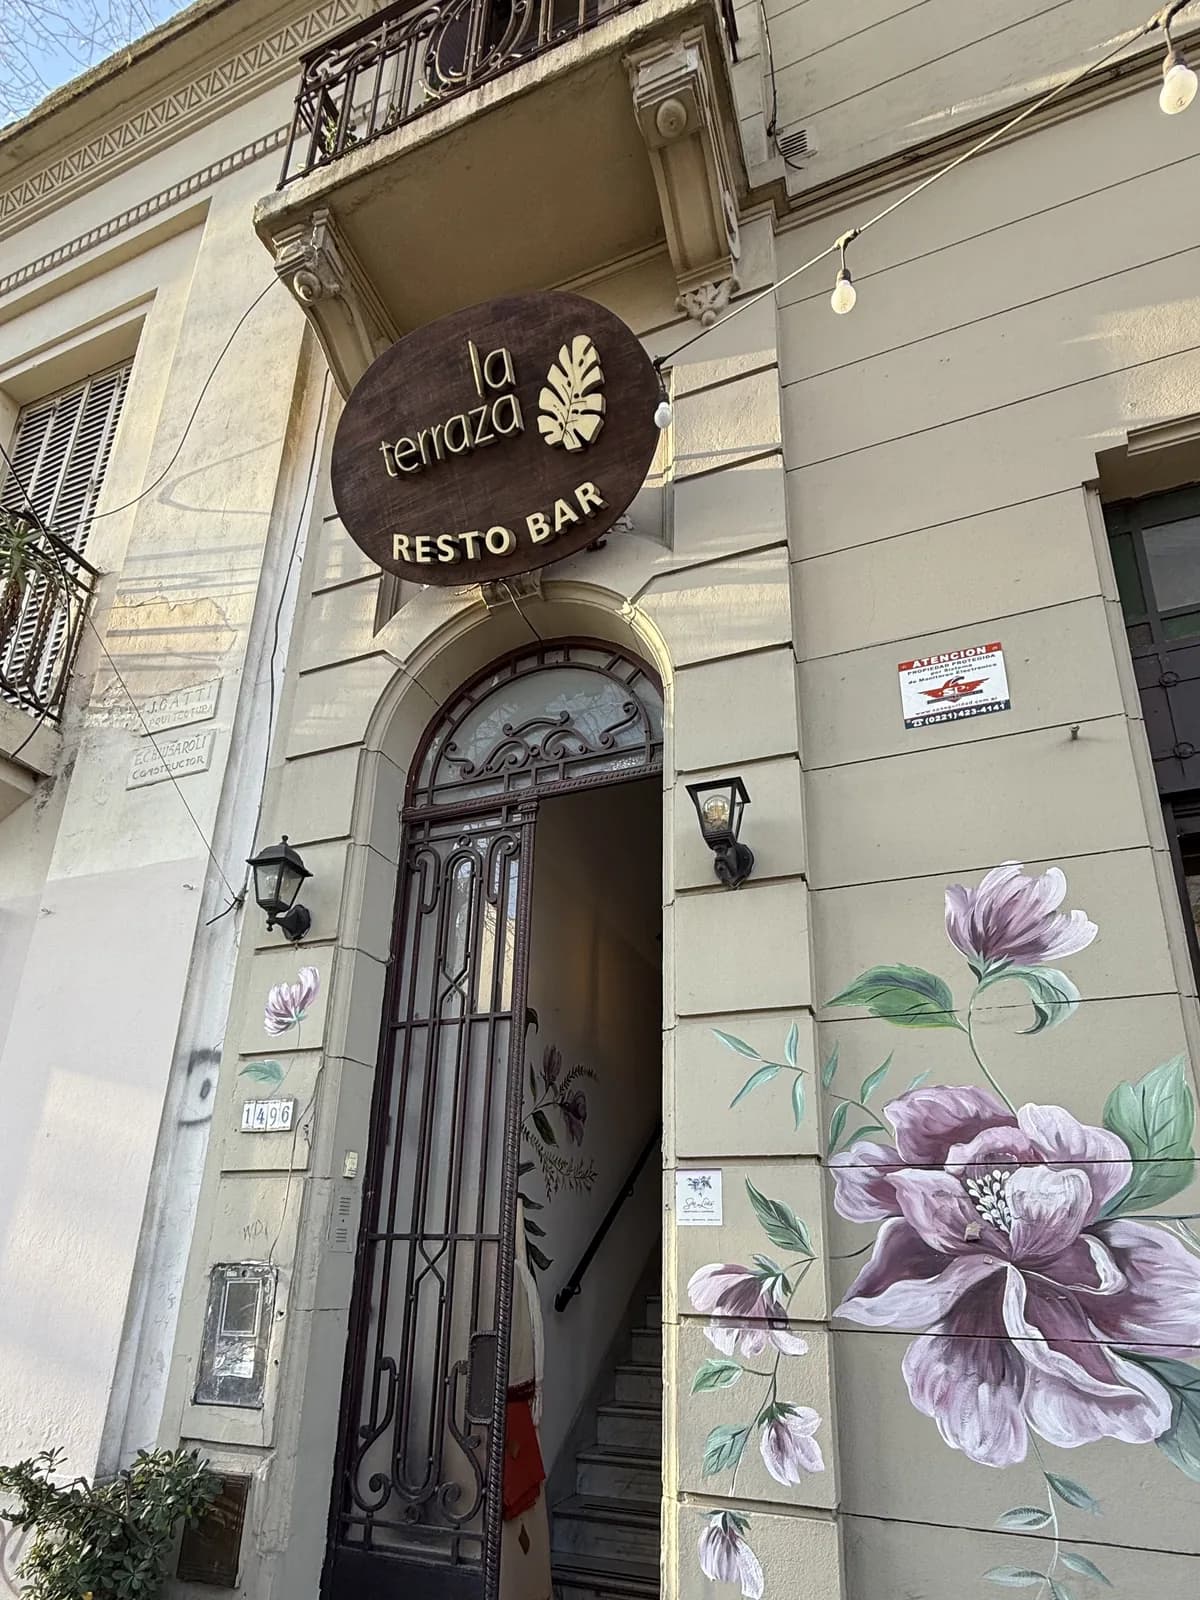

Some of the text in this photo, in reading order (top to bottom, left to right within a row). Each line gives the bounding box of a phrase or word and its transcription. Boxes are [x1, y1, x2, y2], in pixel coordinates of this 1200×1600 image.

[468, 340, 516, 397] la
[379, 394, 524, 478] terraza
[393, 481, 608, 564] RESTO BAR
[907, 653, 996, 676] PROPIEDAD PROTEGIDA
[912, 646, 986, 668] ATENCION
[245, 1105, 291, 1127] 1496
